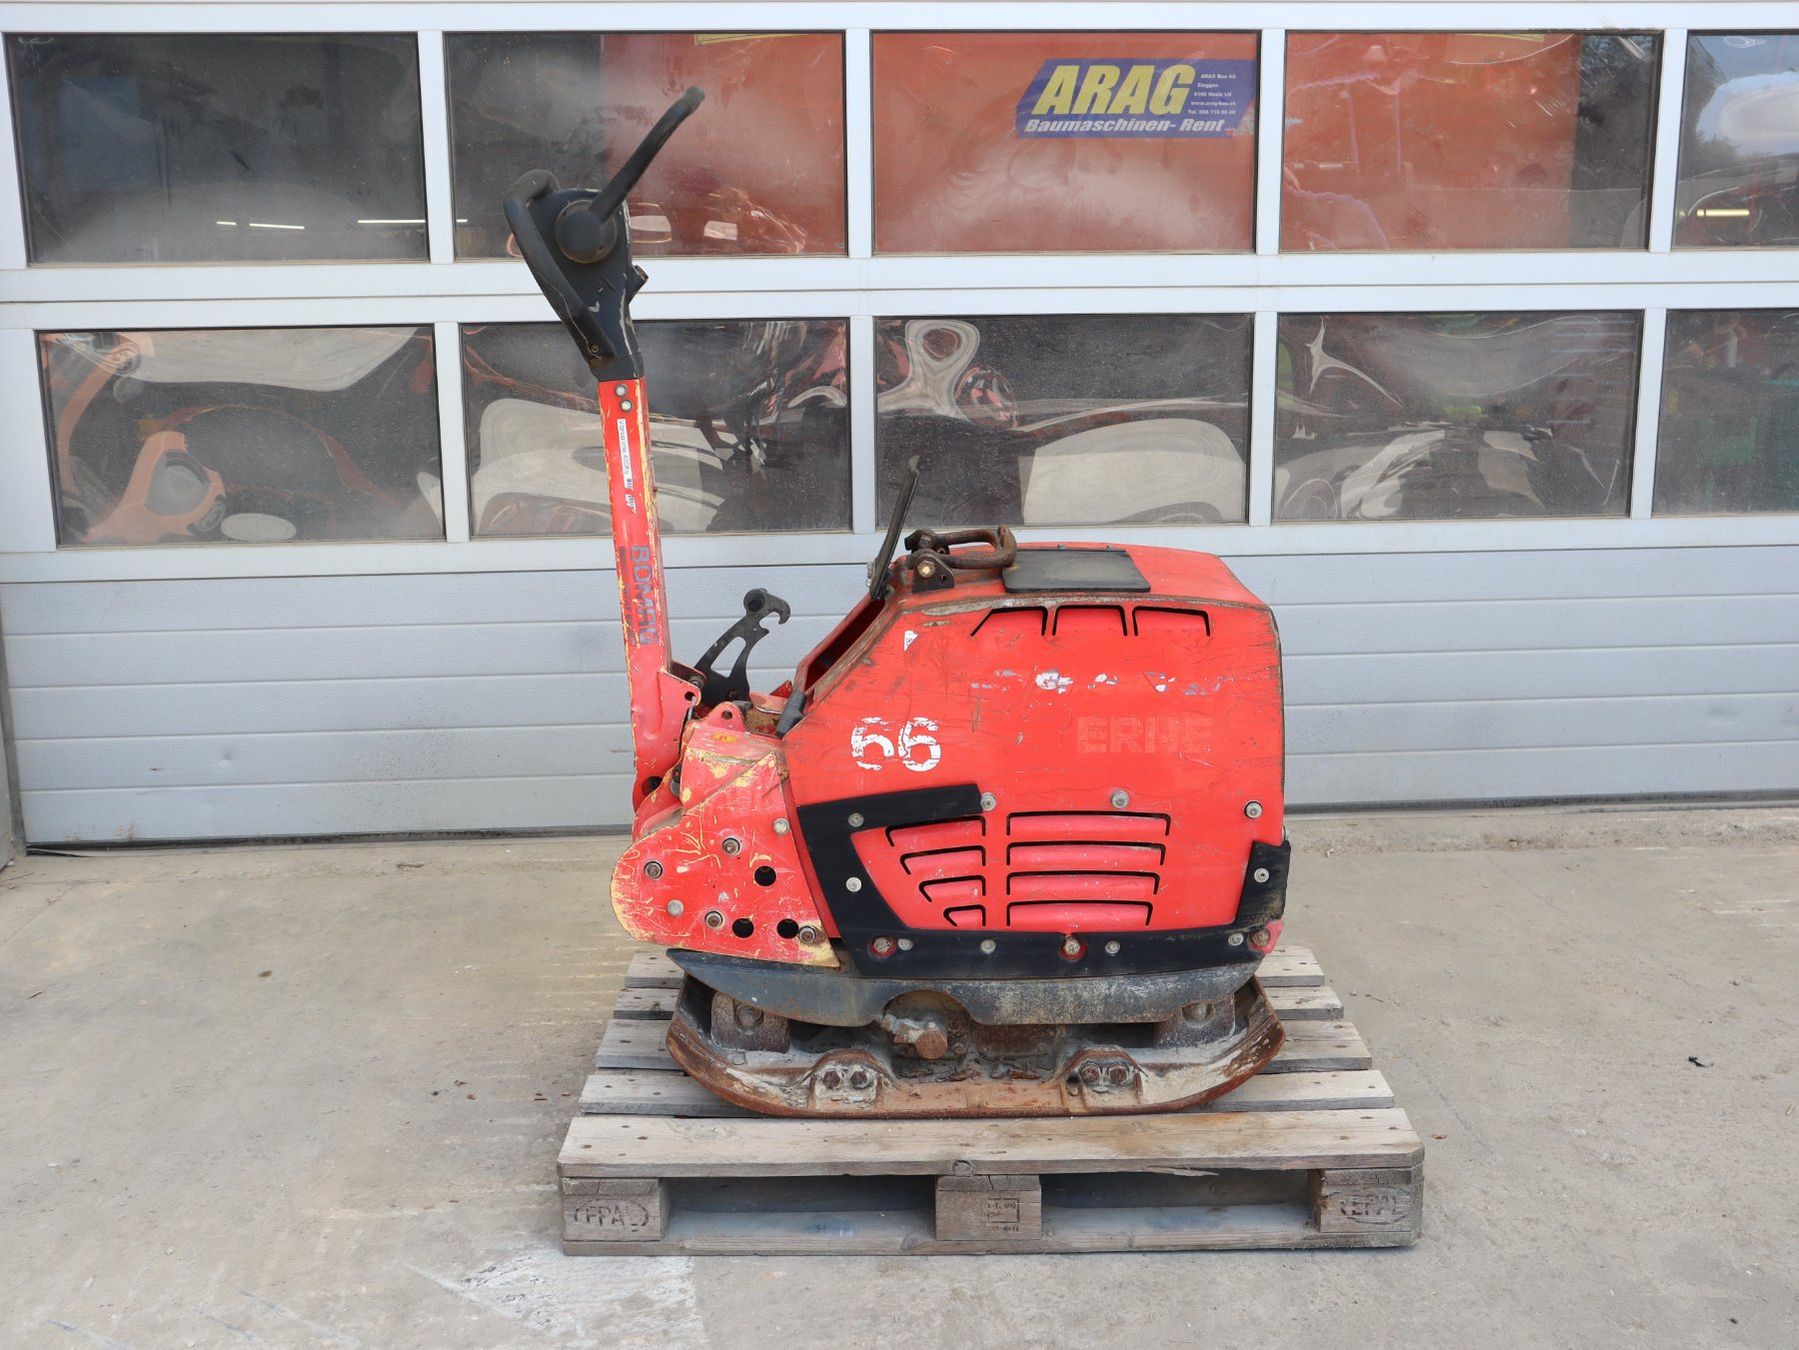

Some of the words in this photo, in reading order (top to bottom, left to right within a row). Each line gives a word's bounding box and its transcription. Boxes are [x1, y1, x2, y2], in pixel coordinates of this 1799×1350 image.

[1031, 64, 1196, 116] ARAG
[1024, 118, 1177, 132] Baumaschinen-
[1179, 118, 1225, 132] Rent
[630, 544, 659, 645] BOMAG
[850, 716, 942, 773] 66
